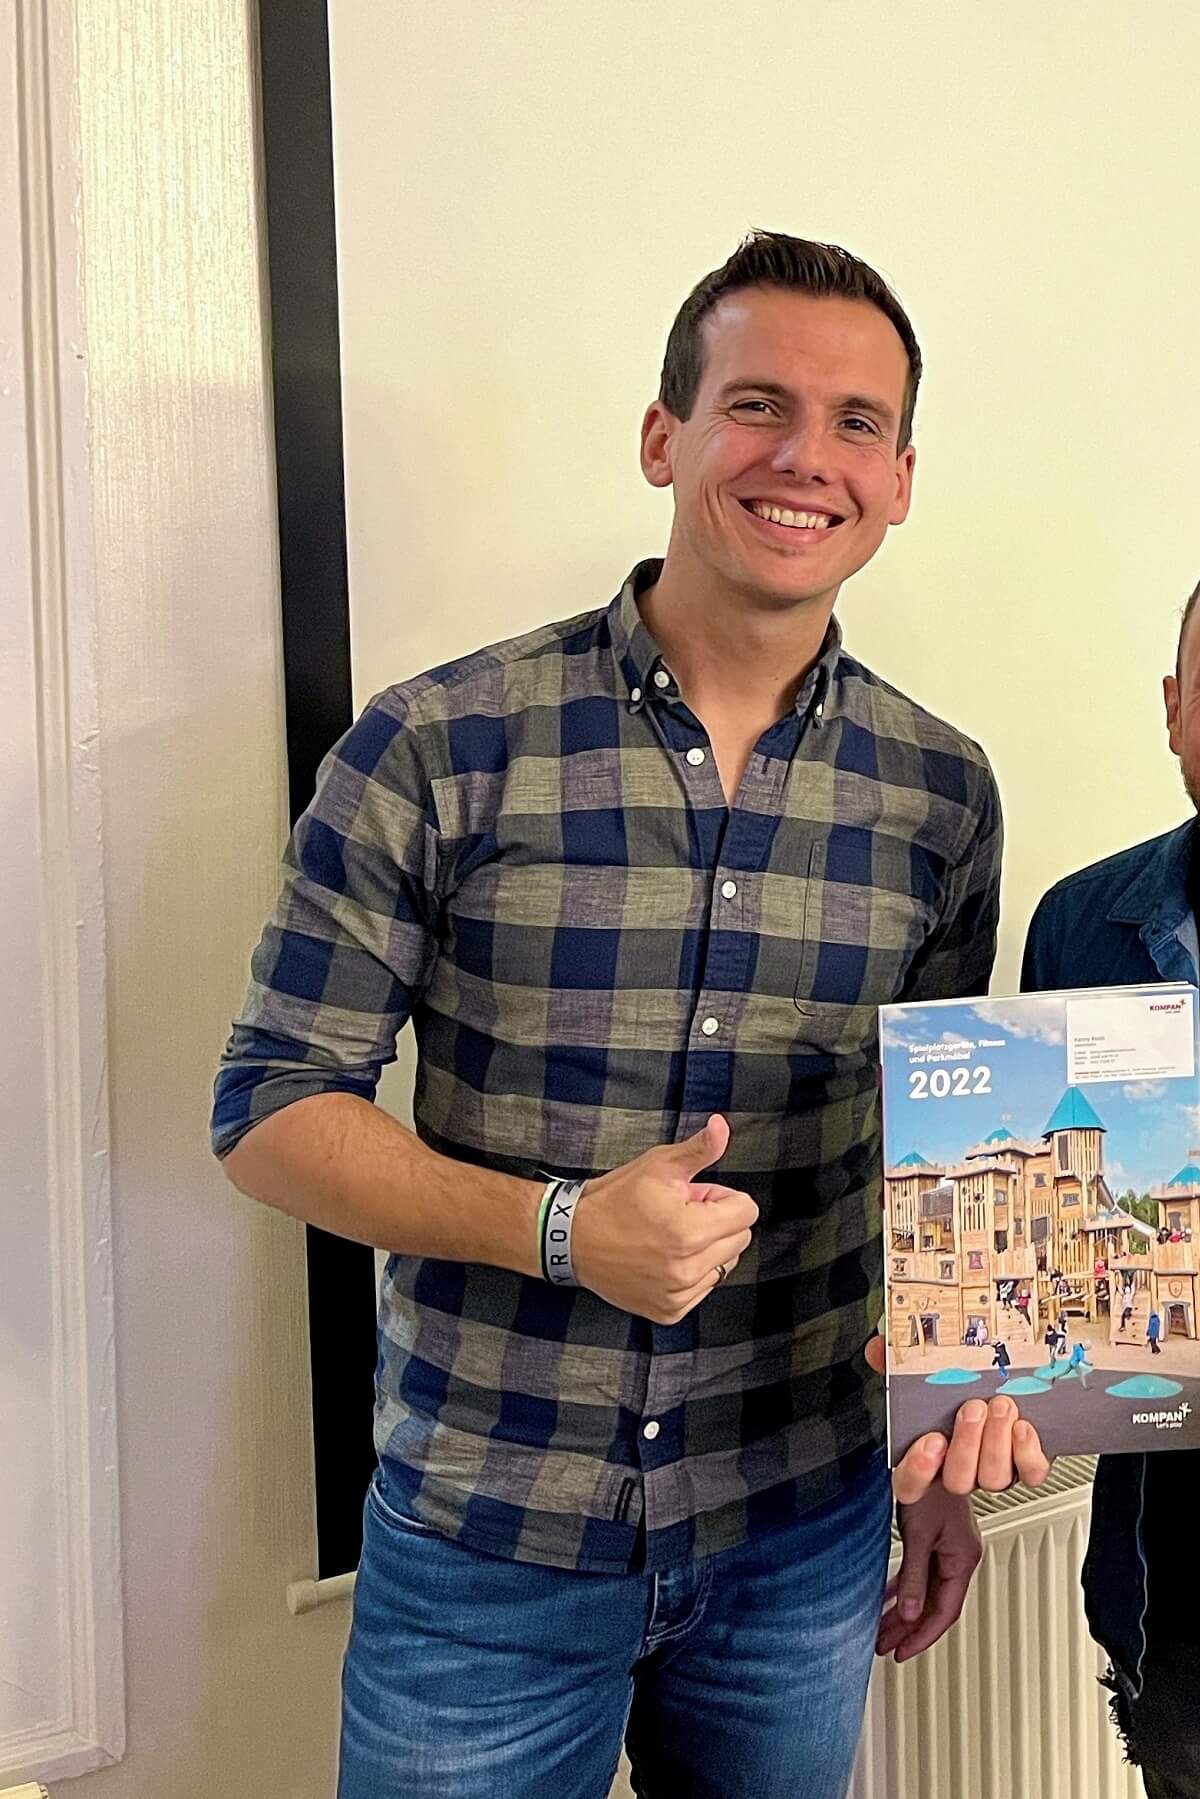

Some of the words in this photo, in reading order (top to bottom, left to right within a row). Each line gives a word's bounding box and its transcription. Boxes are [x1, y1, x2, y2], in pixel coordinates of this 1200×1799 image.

[909, 1055, 926, 1064] und
[909, 1066, 992, 1099] 2022
[1132, 1411, 1183, 1424] KOMPAN
